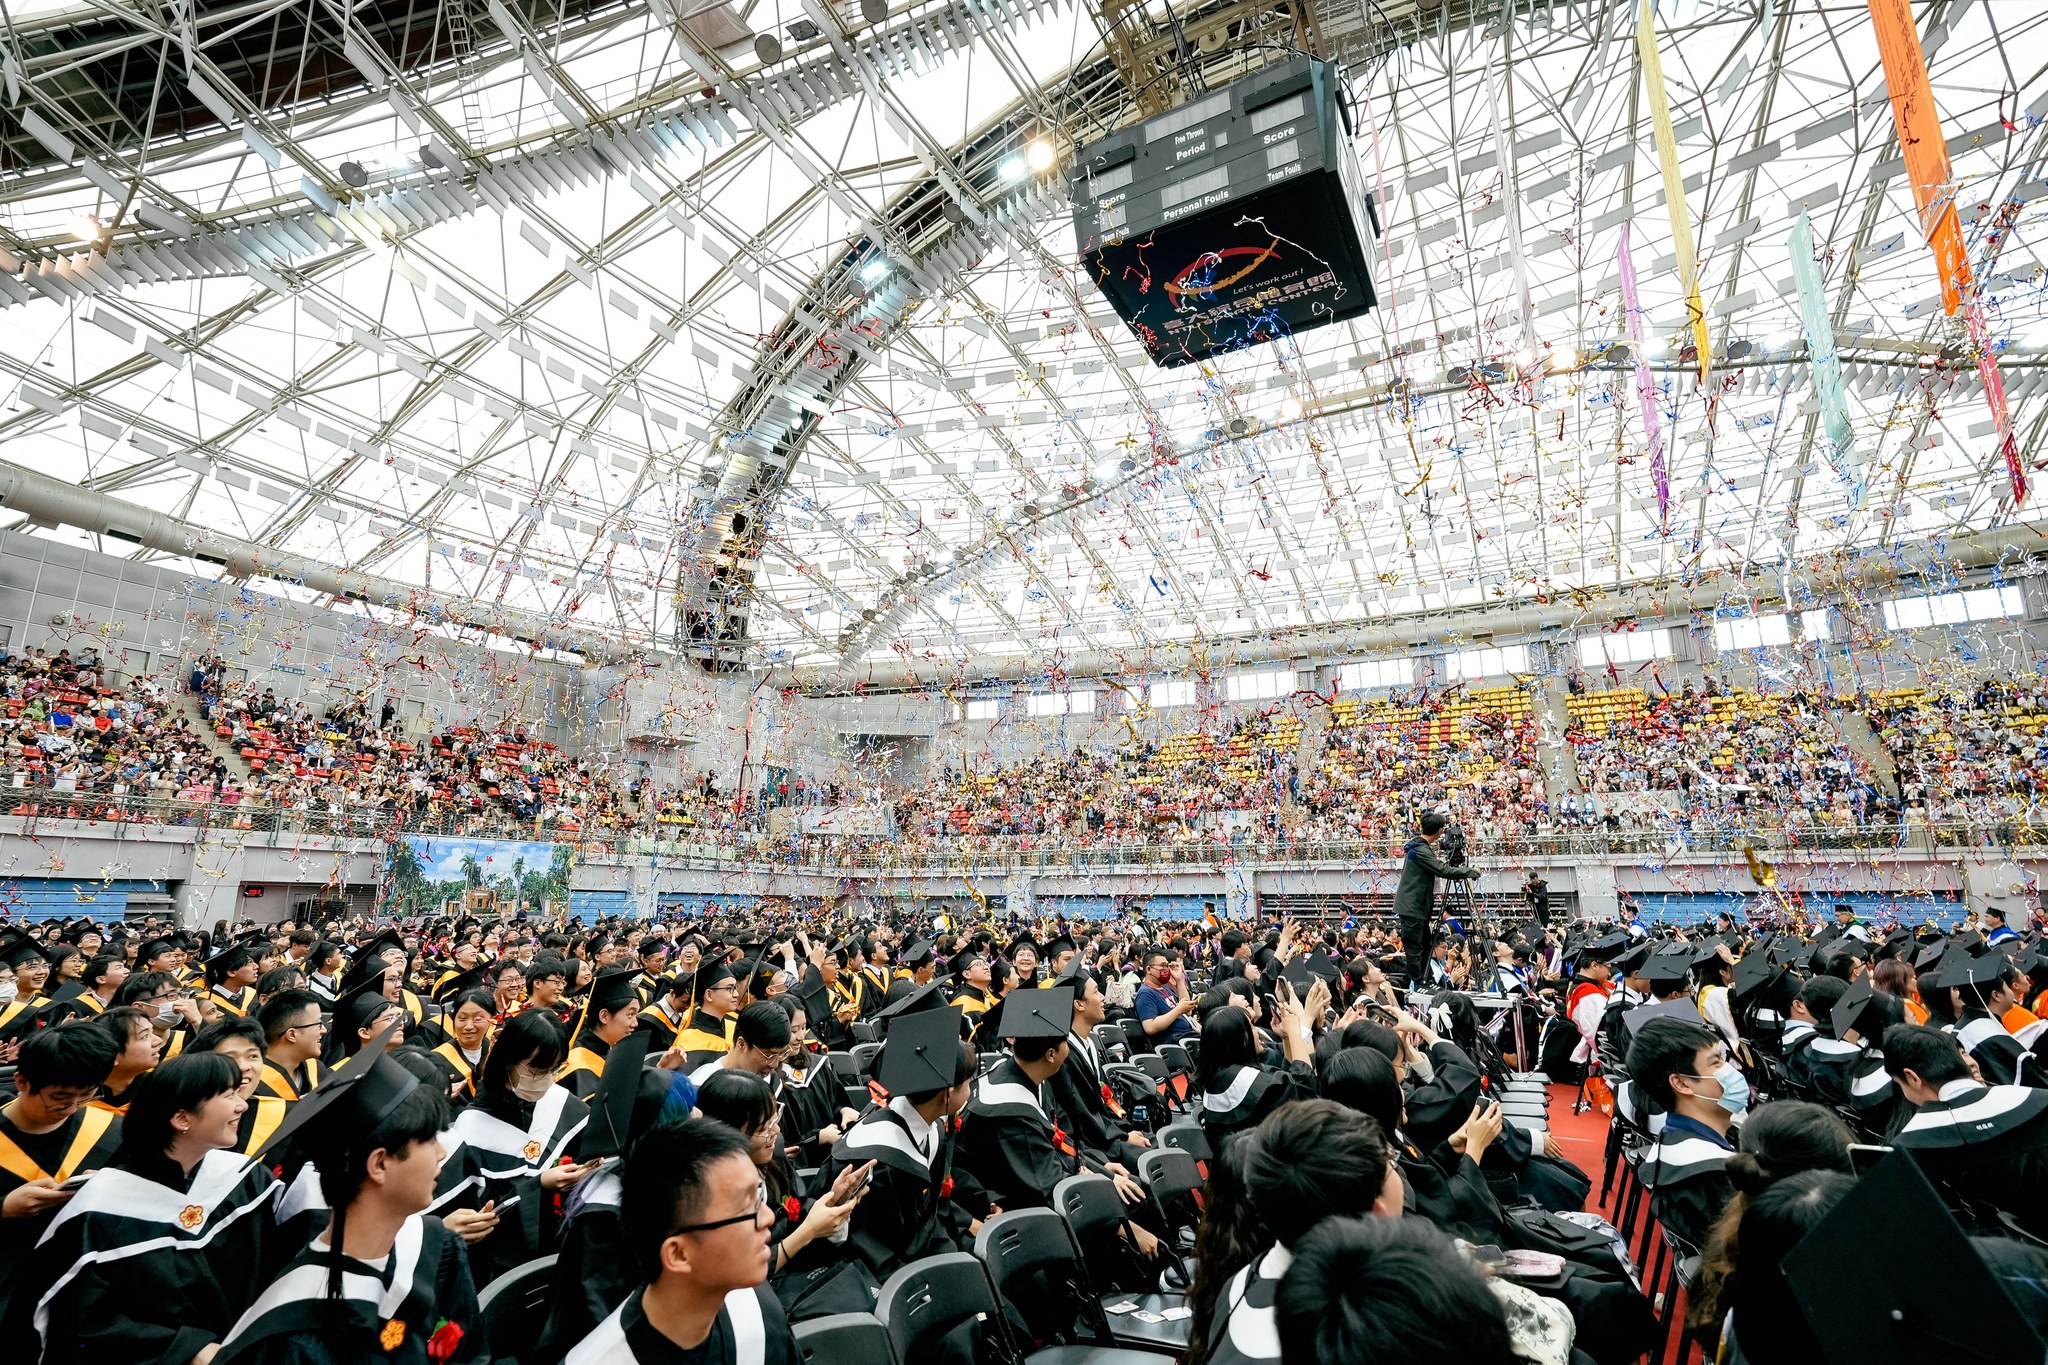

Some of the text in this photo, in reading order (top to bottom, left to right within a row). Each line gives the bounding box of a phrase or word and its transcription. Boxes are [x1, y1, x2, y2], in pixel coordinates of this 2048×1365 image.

[1174, 128, 1205, 145] Free Throws
[1263, 127, 1296, 144] Score
[1176, 141, 1206, 161] Period
[1267, 163, 1301, 182] Team Fouls
[1099, 193, 1126, 208] Score
[1164, 191, 1230, 221] Personal Fouls
[1233, 284, 1254, 295] Let's
[1255, 276, 1280, 288] work
[1281, 270, 1299, 280] out
[1203, 301, 1264, 325] SPORT
[1268, 281, 1336, 305] CENTER
